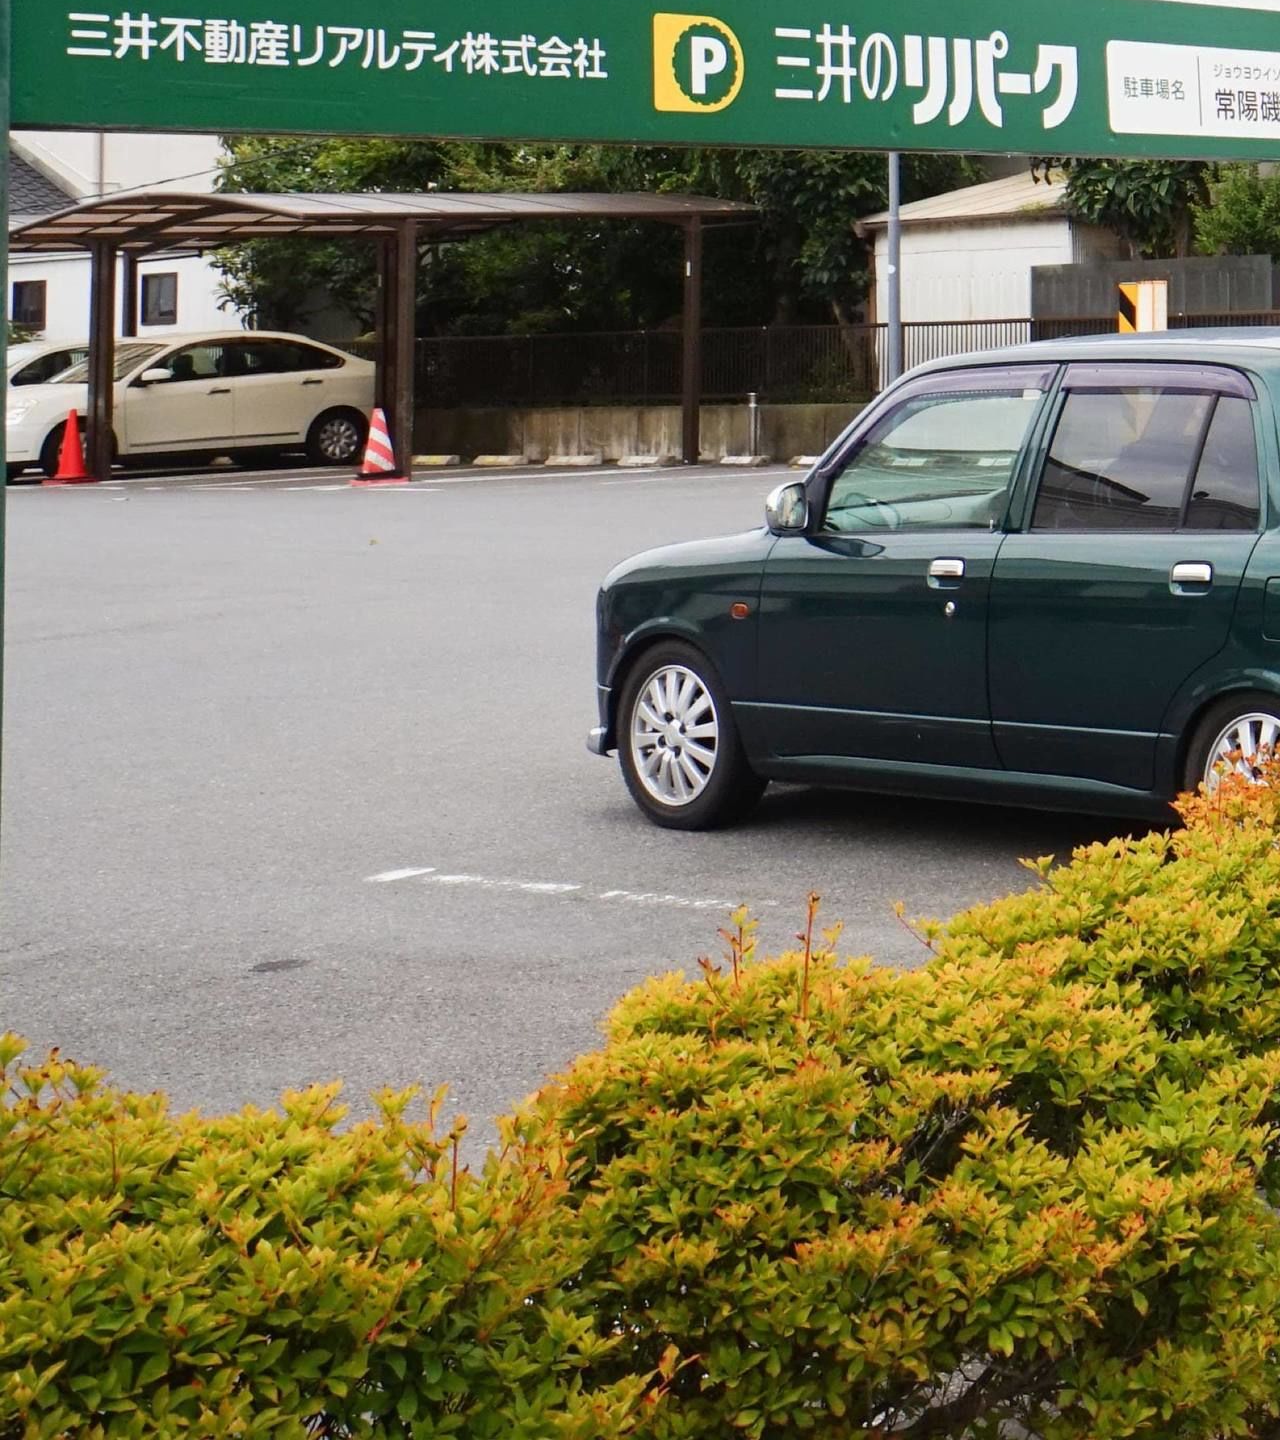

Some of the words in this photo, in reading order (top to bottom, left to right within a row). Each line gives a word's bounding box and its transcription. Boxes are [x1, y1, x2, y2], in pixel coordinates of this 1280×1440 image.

[67, 12, 608, 79] 三井不動産リアルティ株式会社
[691, 37, 727, 94] P
[775, 23, 1078, 129] 三井のリパーク
[1123, 76, 1185, 102] 駐車場名
